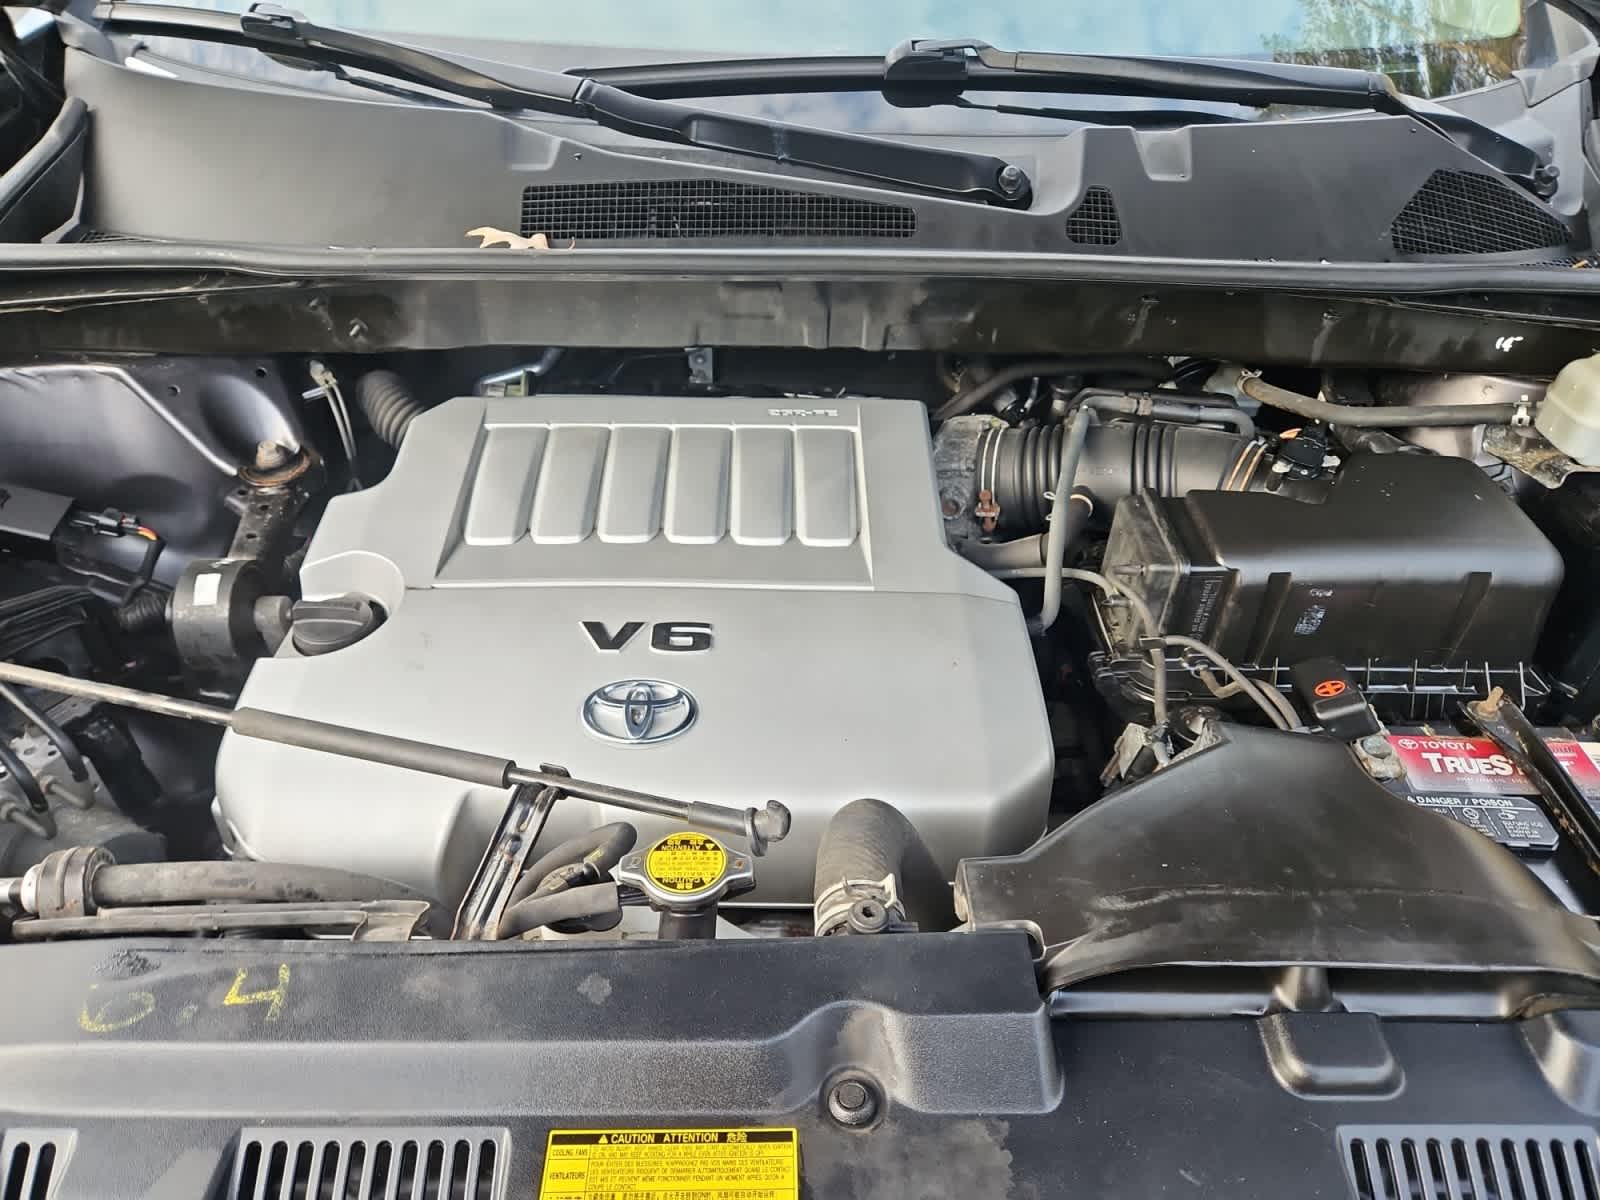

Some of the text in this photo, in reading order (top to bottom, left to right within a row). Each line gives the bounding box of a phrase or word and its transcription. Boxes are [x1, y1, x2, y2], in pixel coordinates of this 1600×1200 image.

[578, 621, 714, 654] V6
[1420, 740, 1477, 751] TOYOTA
[1416, 796, 1461, 806] DANGER
[1472, 798, 1513, 807] POISON
[611, 1134, 655, 1144] CAUTION
[663, 1132, 719, 1143] ATTENTION
